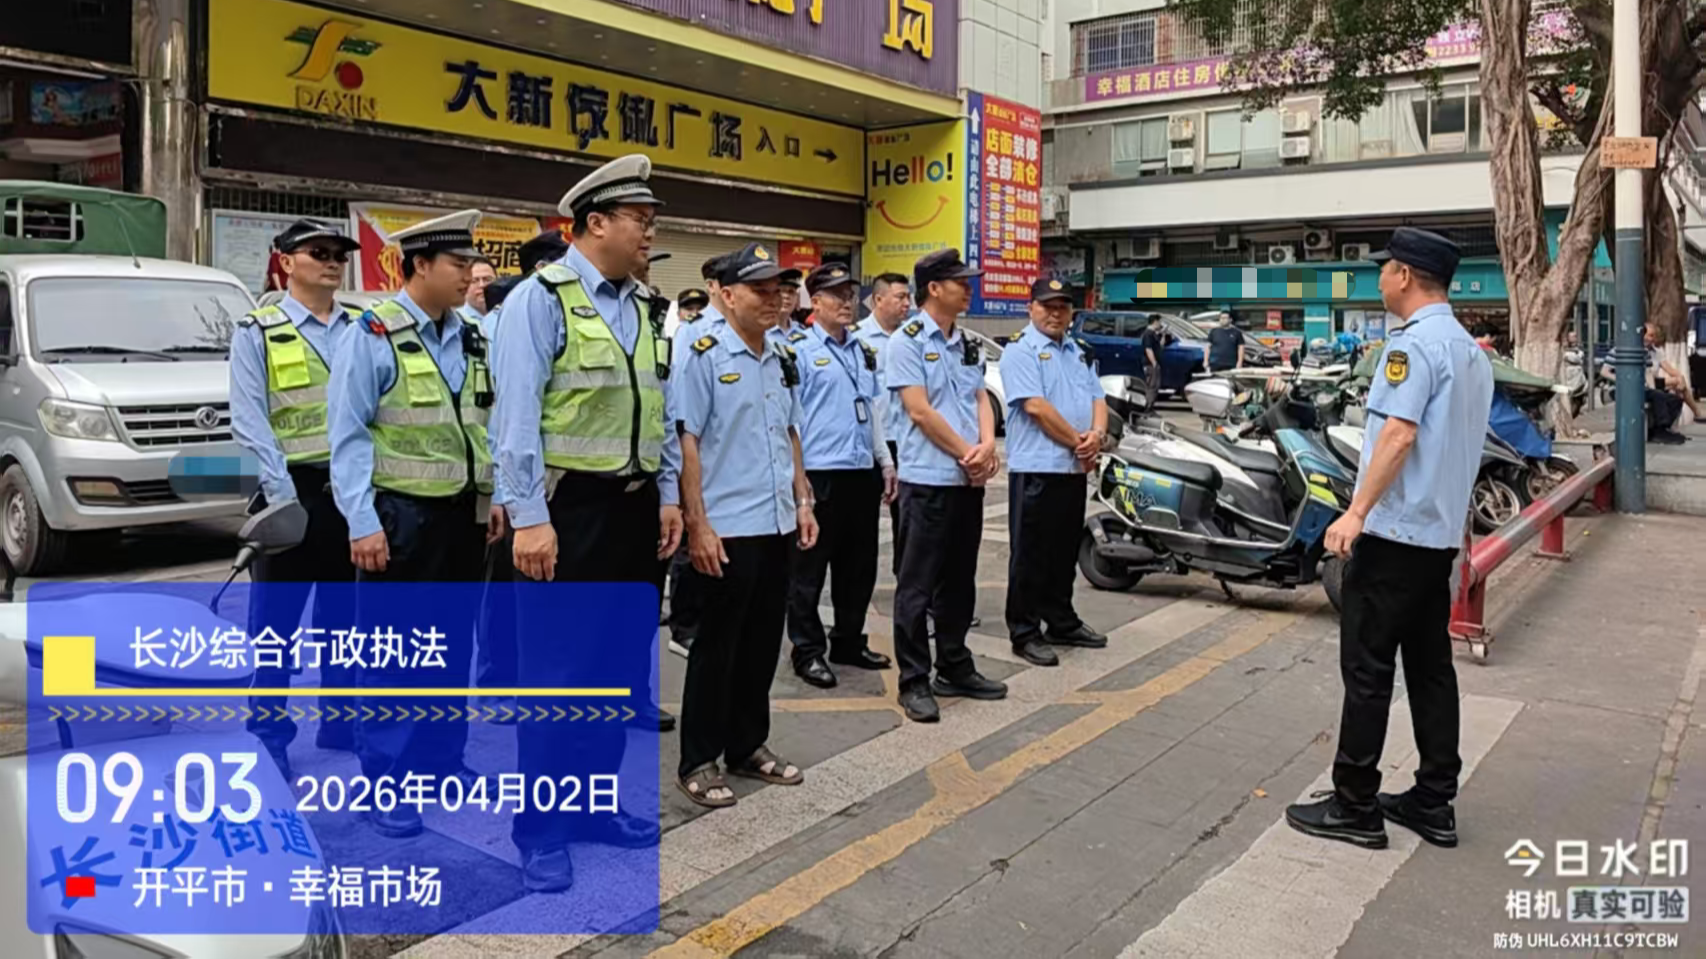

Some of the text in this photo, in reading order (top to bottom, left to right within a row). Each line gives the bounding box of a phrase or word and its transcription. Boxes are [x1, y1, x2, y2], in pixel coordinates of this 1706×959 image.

[295, 86, 376, 120] DAXIN
[756, 126, 801, 157] 入口
[872, 152, 953, 187] Hello!
[40, 806, 317, 910] 长沙街道
